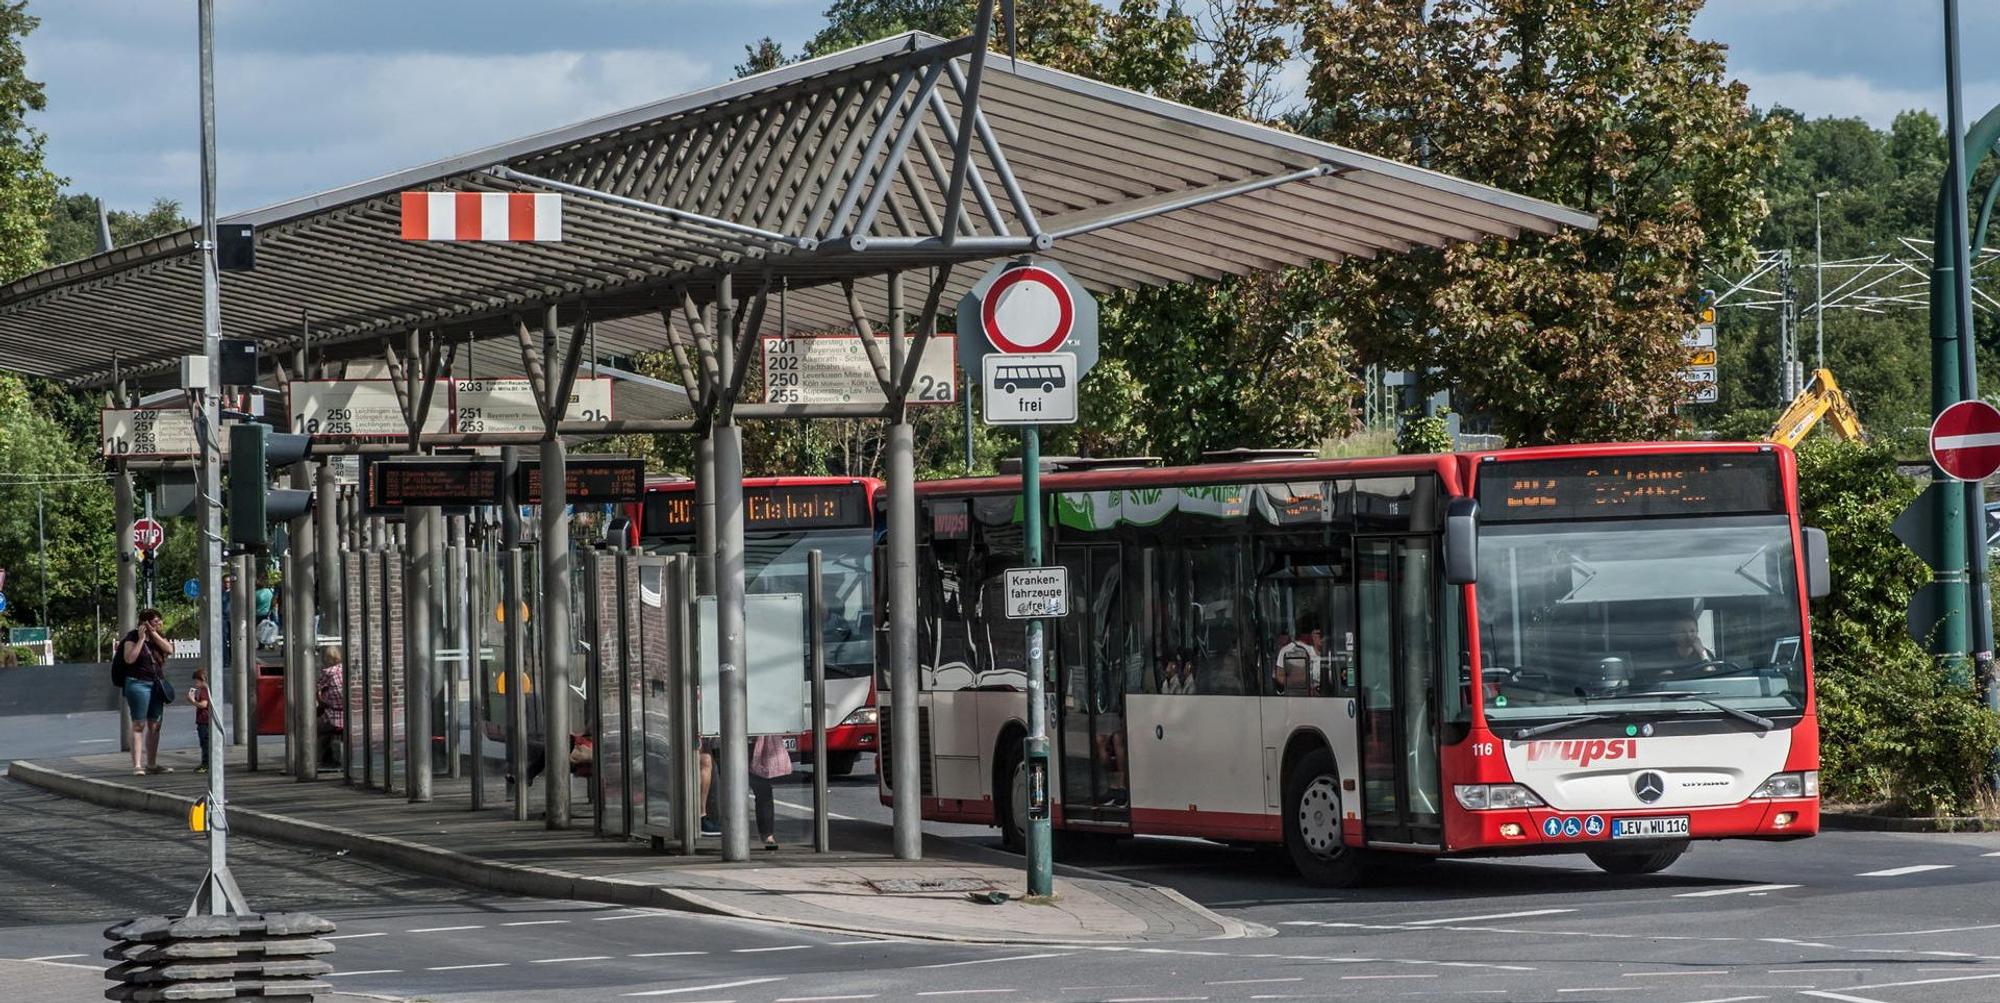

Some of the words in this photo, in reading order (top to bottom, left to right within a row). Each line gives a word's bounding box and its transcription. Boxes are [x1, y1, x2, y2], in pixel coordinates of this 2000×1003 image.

[769, 340, 796, 354] 201
[769, 357, 798, 370] 202
[769, 373, 798, 386] 250
[459, 382, 482, 392] 203
[919, 375, 951, 400] 2a
[770, 389, 799, 402] 255
[1019, 397, 1042, 411] frei
[134, 411, 156, 420] 202
[327, 409, 351, 420] 250
[460, 408, 482, 418] 251
[134, 422, 154, 431] 251
[295, 413, 319, 433] 1a
[327, 423, 352, 433] 255
[460, 421, 484, 432] 253
[135, 433, 156, 442] 253
[107, 437, 129, 454] 1b
[135, 444, 156, 453] 253
[668, 499, 696, 524] 20
[1388, 502, 1399, 516] 116
[1012, 576, 1060, 586] Kranken-
[1011, 589, 1062, 599] fahrzeuge
[1028, 600, 1046, 610] frei
[1472, 743, 1493, 756] 116
[1620, 821, 1642, 835] LEV
[1650, 820, 1664, 833] WU
[1667, 819, 1688, 833] 116
